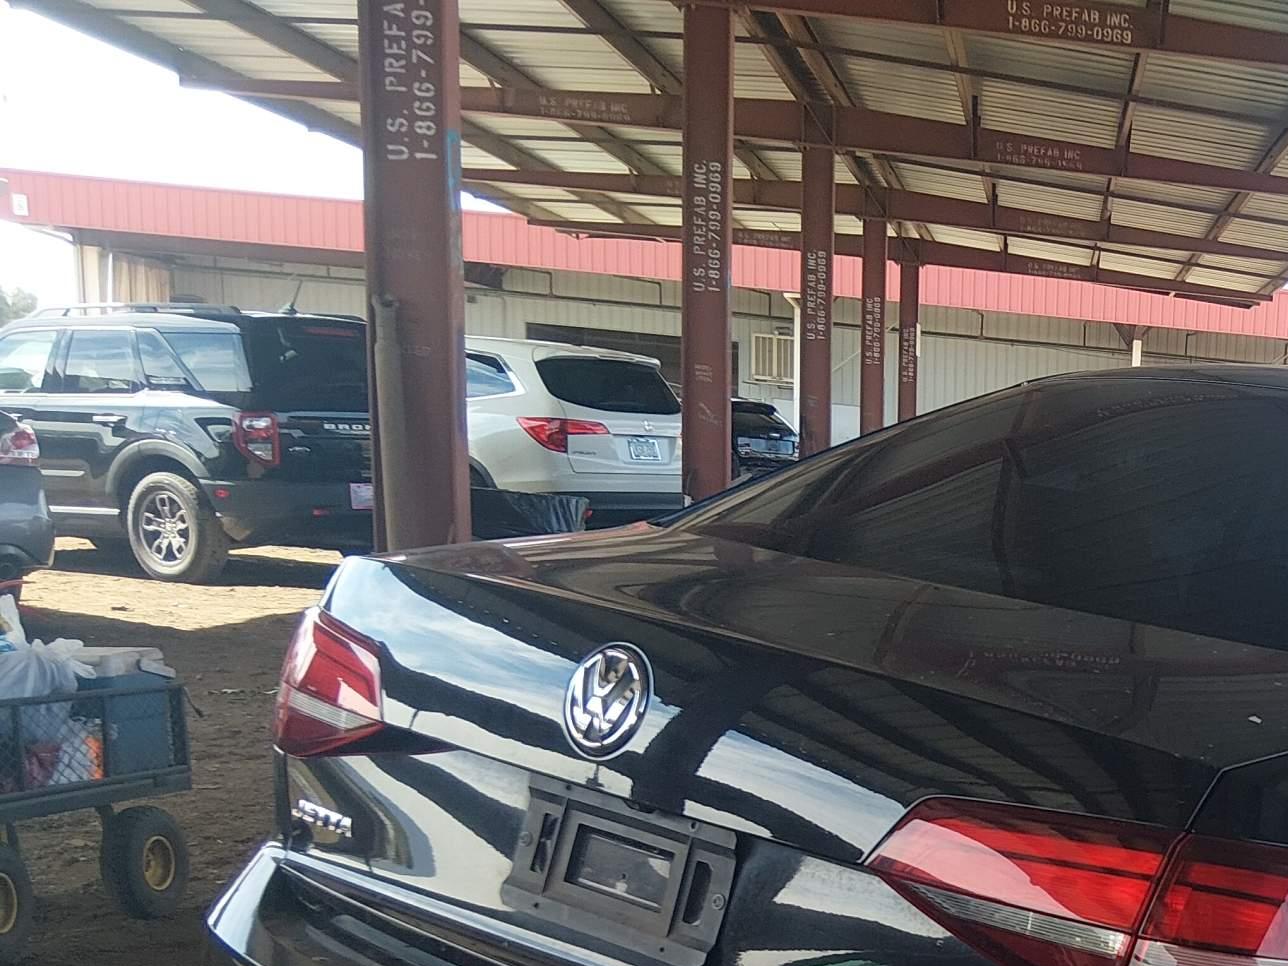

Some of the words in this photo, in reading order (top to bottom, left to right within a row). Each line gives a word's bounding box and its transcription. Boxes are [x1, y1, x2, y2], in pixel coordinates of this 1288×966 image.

[1008, 16, 1132, 44] 1-866-799-0969
[1043, 4, 1100, 24] PREFAB
[1106, 10, 1134, 29] INC.
[386, 109, 409, 160] U.S.
[694, 159, 707, 189] INC.
[693, 196, 706, 255] PREFAB
[708, 161, 721, 292] 1-866-799-0969
[692, 263, 706, 292] U.S.
[807, 274, 816, 315] PREFAB
